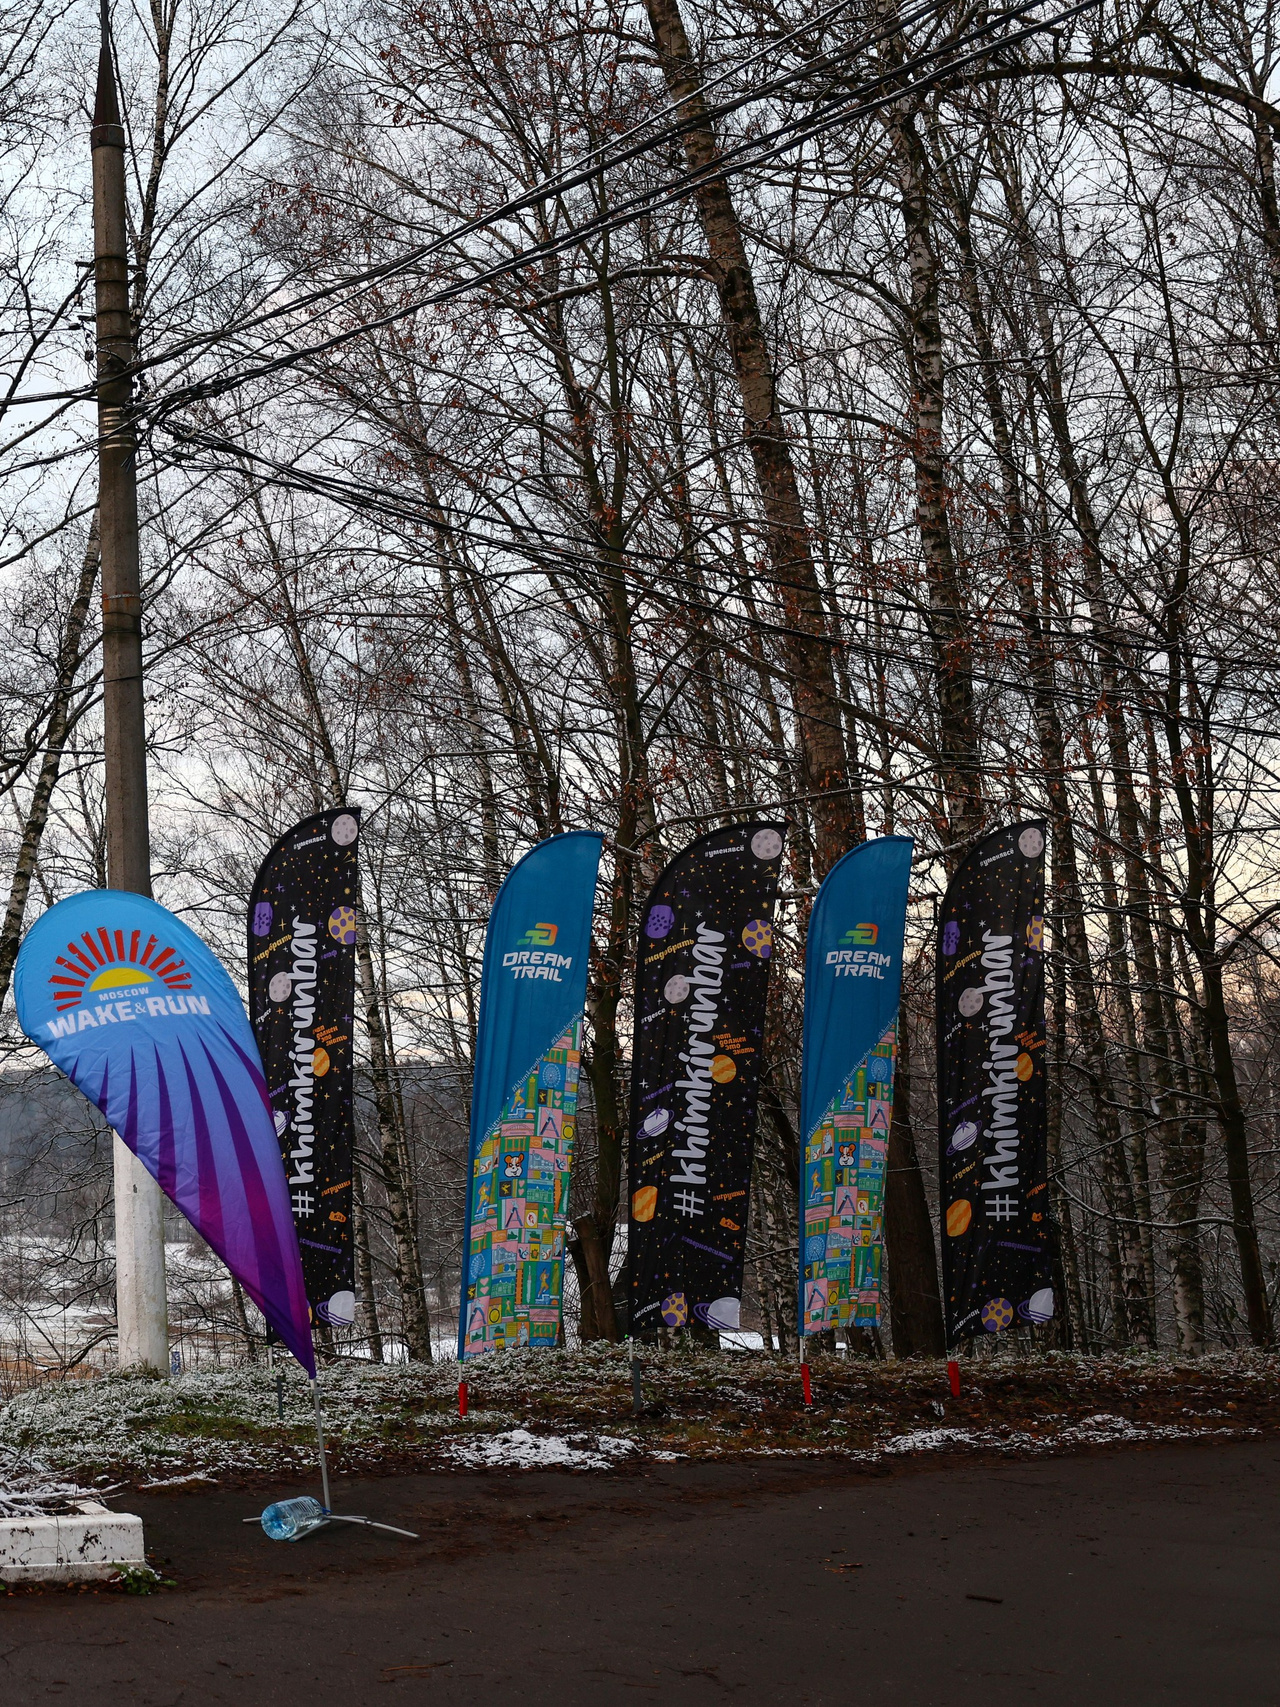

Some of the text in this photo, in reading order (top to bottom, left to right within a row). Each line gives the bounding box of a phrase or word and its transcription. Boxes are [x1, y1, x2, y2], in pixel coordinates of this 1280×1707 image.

[502, 951, 572, 970] DREAM
[825, 950, 891, 968] DREAM
[510, 966, 563, 982] TRAIL
[834, 964, 885, 980] TRAIL
[98, 986, 150, 1001] MOSCOW
[286, 915, 318, 1219] #khimkirunbar
[670, 921, 727, 1218] #khimkirunbar
[975, 929, 1020, 1221] #khimkirunbar
